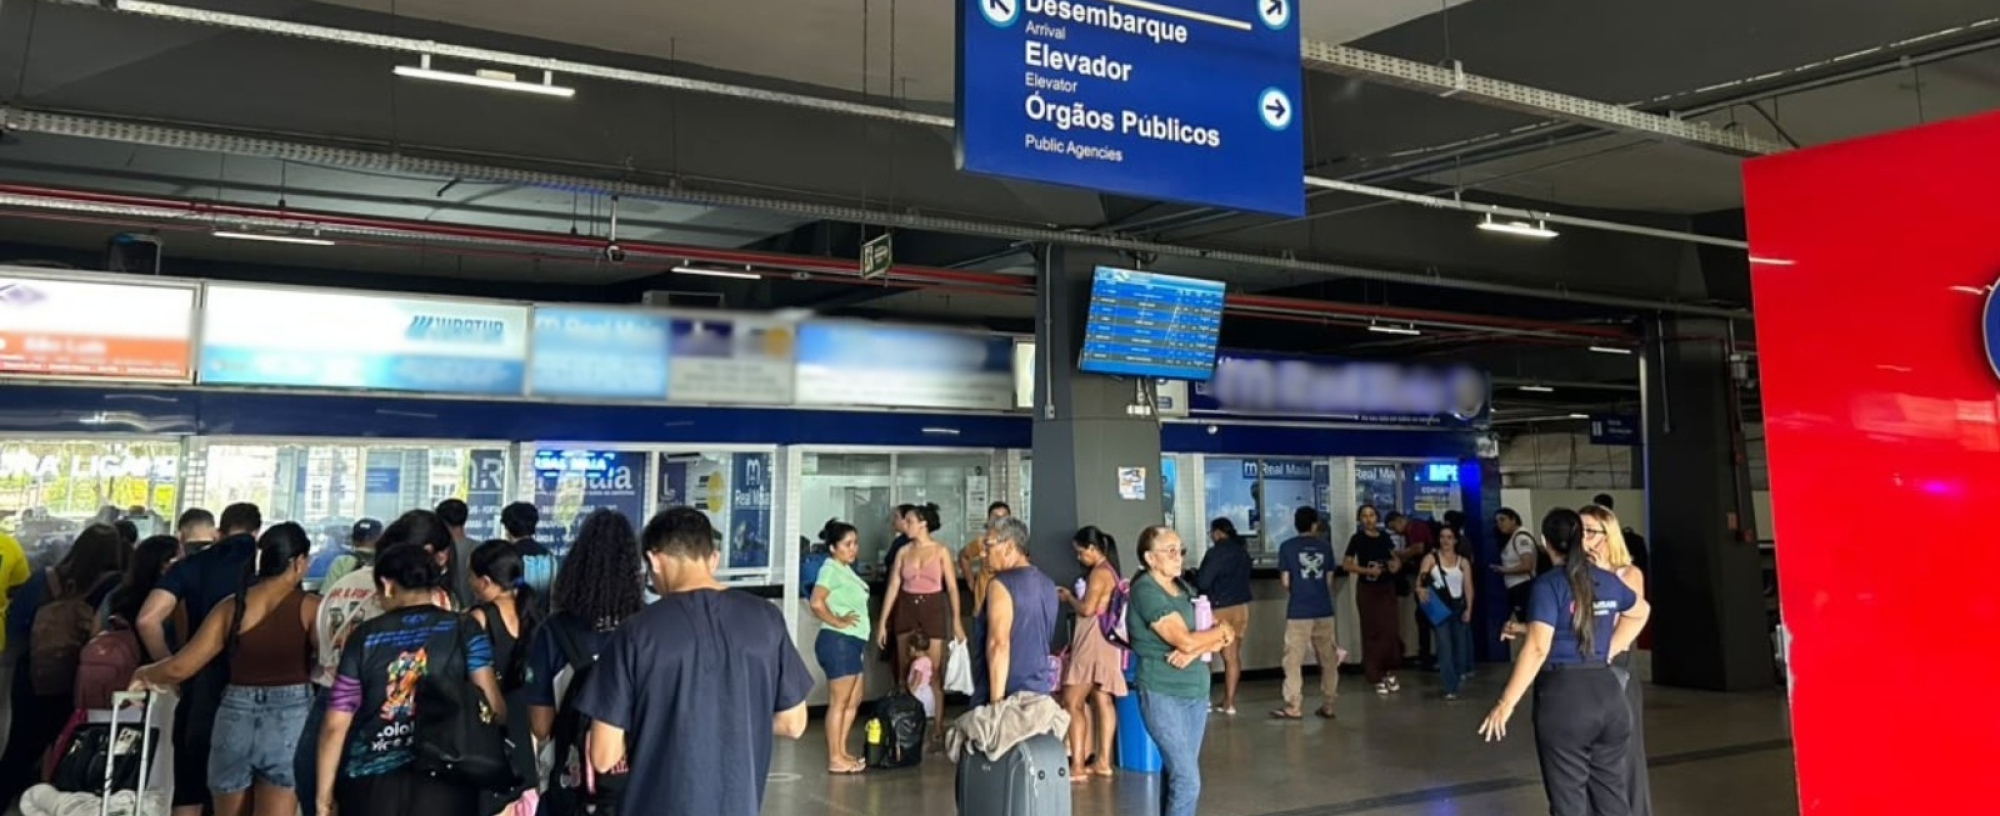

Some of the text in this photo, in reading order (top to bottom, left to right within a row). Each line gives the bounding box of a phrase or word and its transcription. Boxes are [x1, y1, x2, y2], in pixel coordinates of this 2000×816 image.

[1025, 0, 1188, 43] Desembarque
[1025, 20, 1066, 40] Arrival
[1025, 40, 1132, 81] Elevador
[1025, 72, 1078, 93] Elevator
[1025, 91, 1221, 147] Órgãos Públicos
[1025, 134, 1124, 162] Public Agencies
